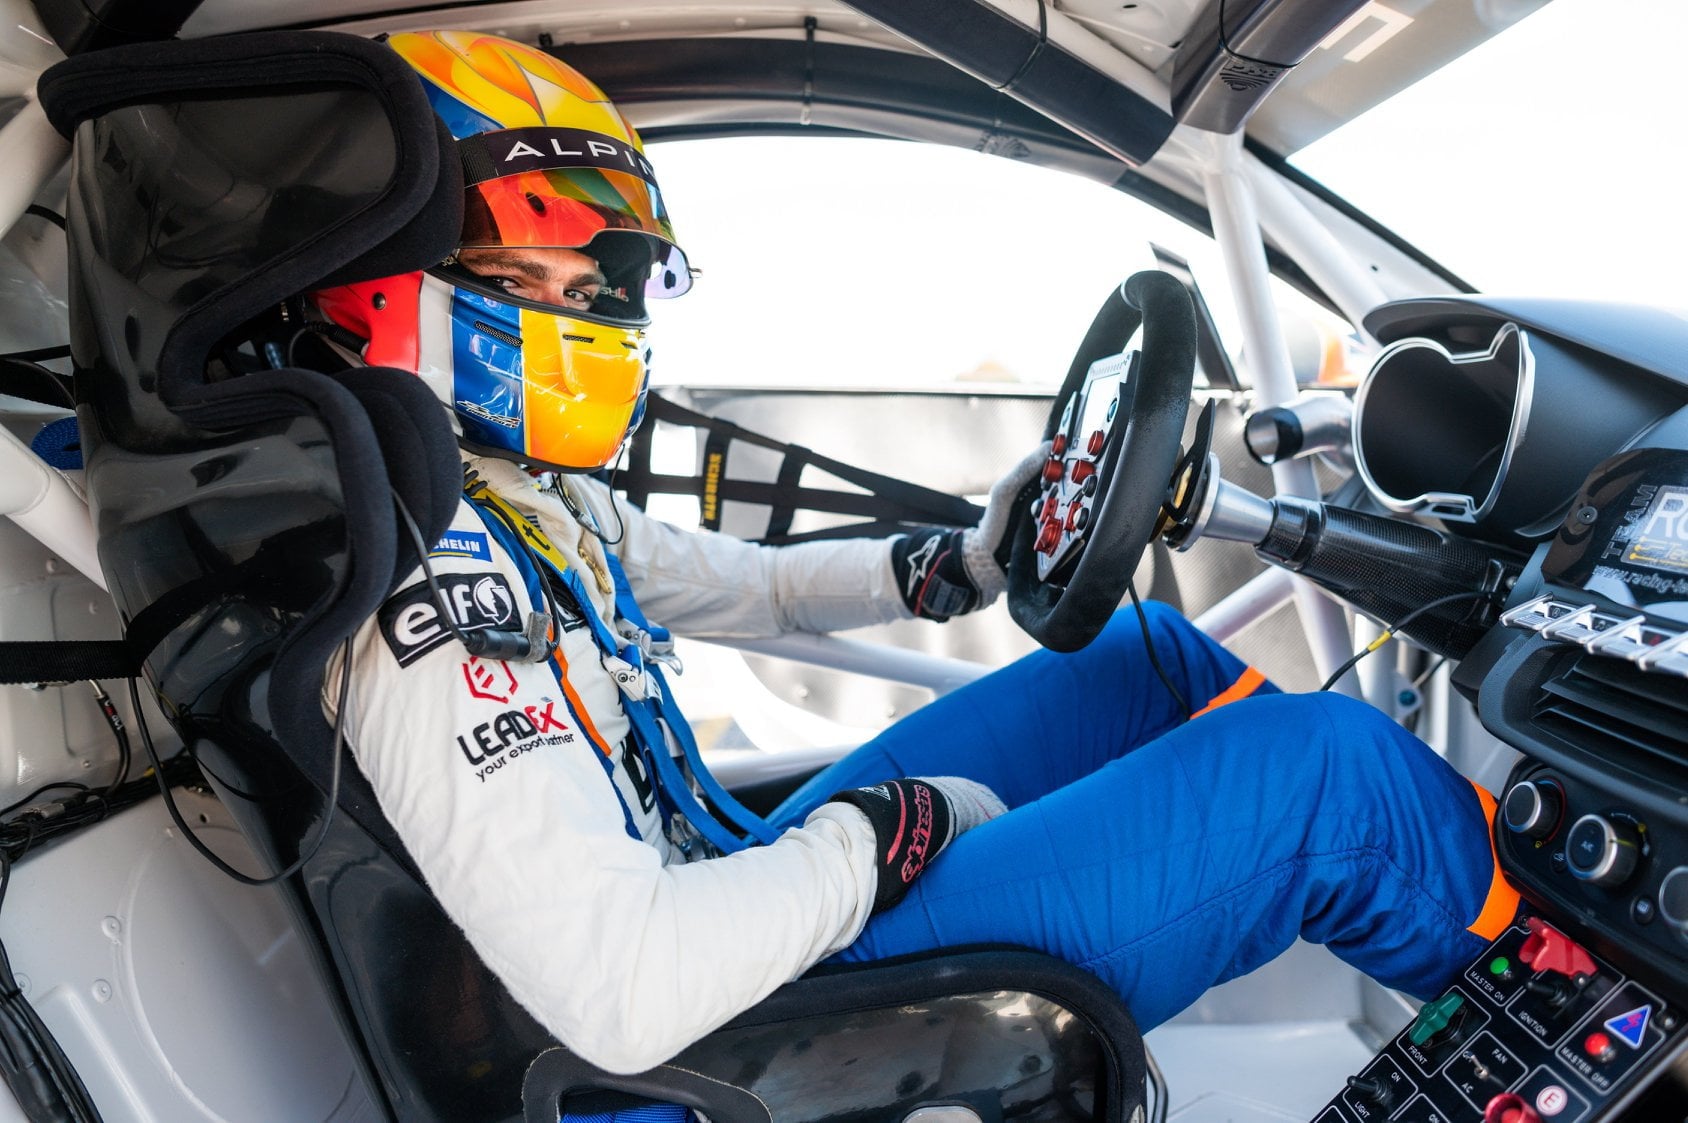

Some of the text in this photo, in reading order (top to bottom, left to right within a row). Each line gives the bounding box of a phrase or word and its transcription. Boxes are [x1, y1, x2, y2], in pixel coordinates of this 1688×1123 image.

[504, 138, 657, 178] ALPIN
[433, 537, 481, 553] HELIN
[394, 584, 473, 646] elf
[457, 702, 569, 766] LEADEX
[475, 756, 507, 783] your
[509, 735, 545, 758] export
[1470, 971, 1505, 1002] MASTER ON
[1517, 1010, 1548, 1038] IGNITION
[1408, 1045, 1428, 1065] FRONT
[1491, 1048, 1509, 1065] FAN
[1391, 1071, 1402, 1083] ON
[1461, 1082, 1475, 1094] AC
[1354, 1100, 1371, 1119] LIGHT
